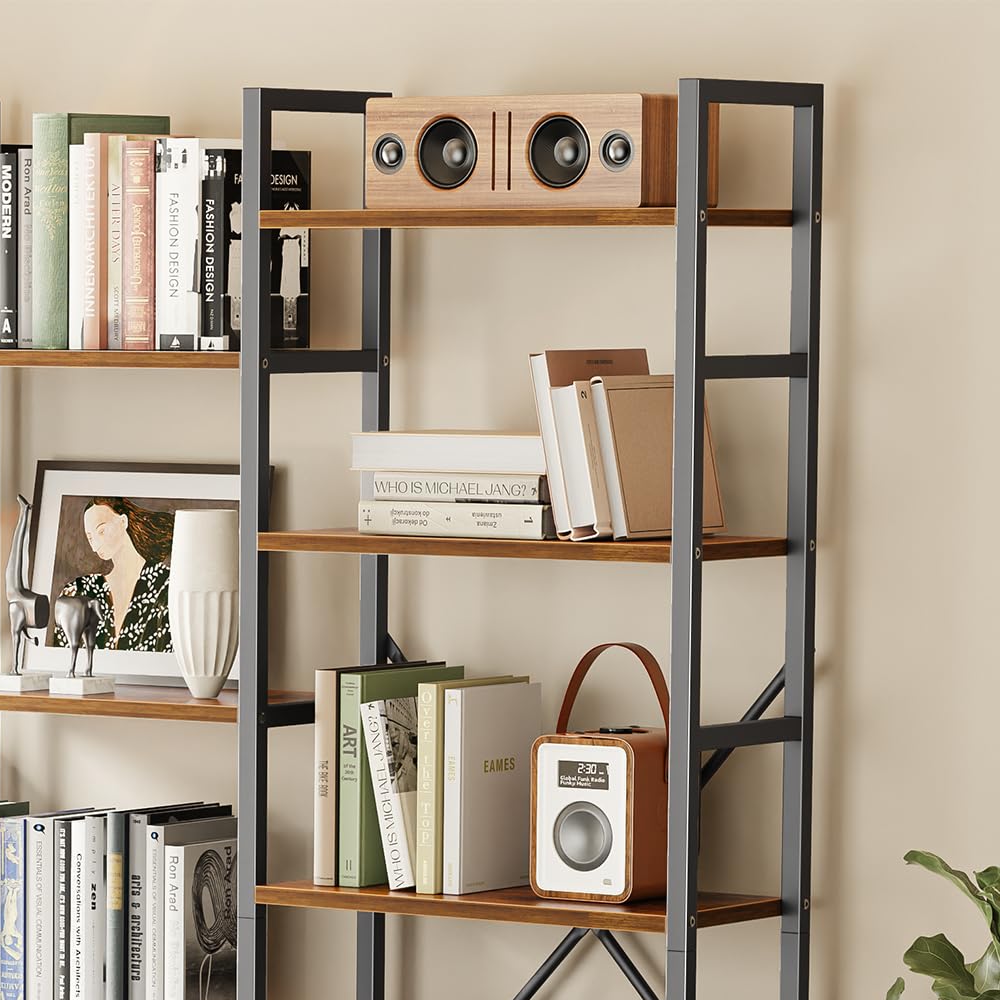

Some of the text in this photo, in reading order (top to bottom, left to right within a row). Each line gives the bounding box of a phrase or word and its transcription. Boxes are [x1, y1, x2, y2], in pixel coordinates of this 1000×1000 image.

[24, 158, 33, 182] Ron
[271, 173, 298, 186] DESIGN
[1, 164, 12, 239] MODERN
[24, 187, 33, 215] Arad
[111, 230, 121, 264] DAYS
[169, 192, 179, 298] FASHION DESIGN
[205, 199, 215, 303] FASHION DESIGN
[374, 480, 527, 496] WHO IS MICHAEL JANG?
[343, 725, 357, 757] ART
[319, 760, 329, 770] THE
[483, 757, 516, 773] EAMES
[577, 763, 597, 775] 2:30
[367, 714, 406, 888] WHO IS MICHAEL JANG?
[169, 855, 180, 879] Ron
[223, 846, 233, 882] Arad
[90, 882, 98, 911] zen
[131, 874, 143, 896] arts
[169, 883, 180, 912] Arad
[35, 840, 43, 978] ESSENTIALS OF VISUAL COMMUNICATION
[74, 853, 83, 998] Conversations with Architects
[131, 914, 143, 981] architecture
